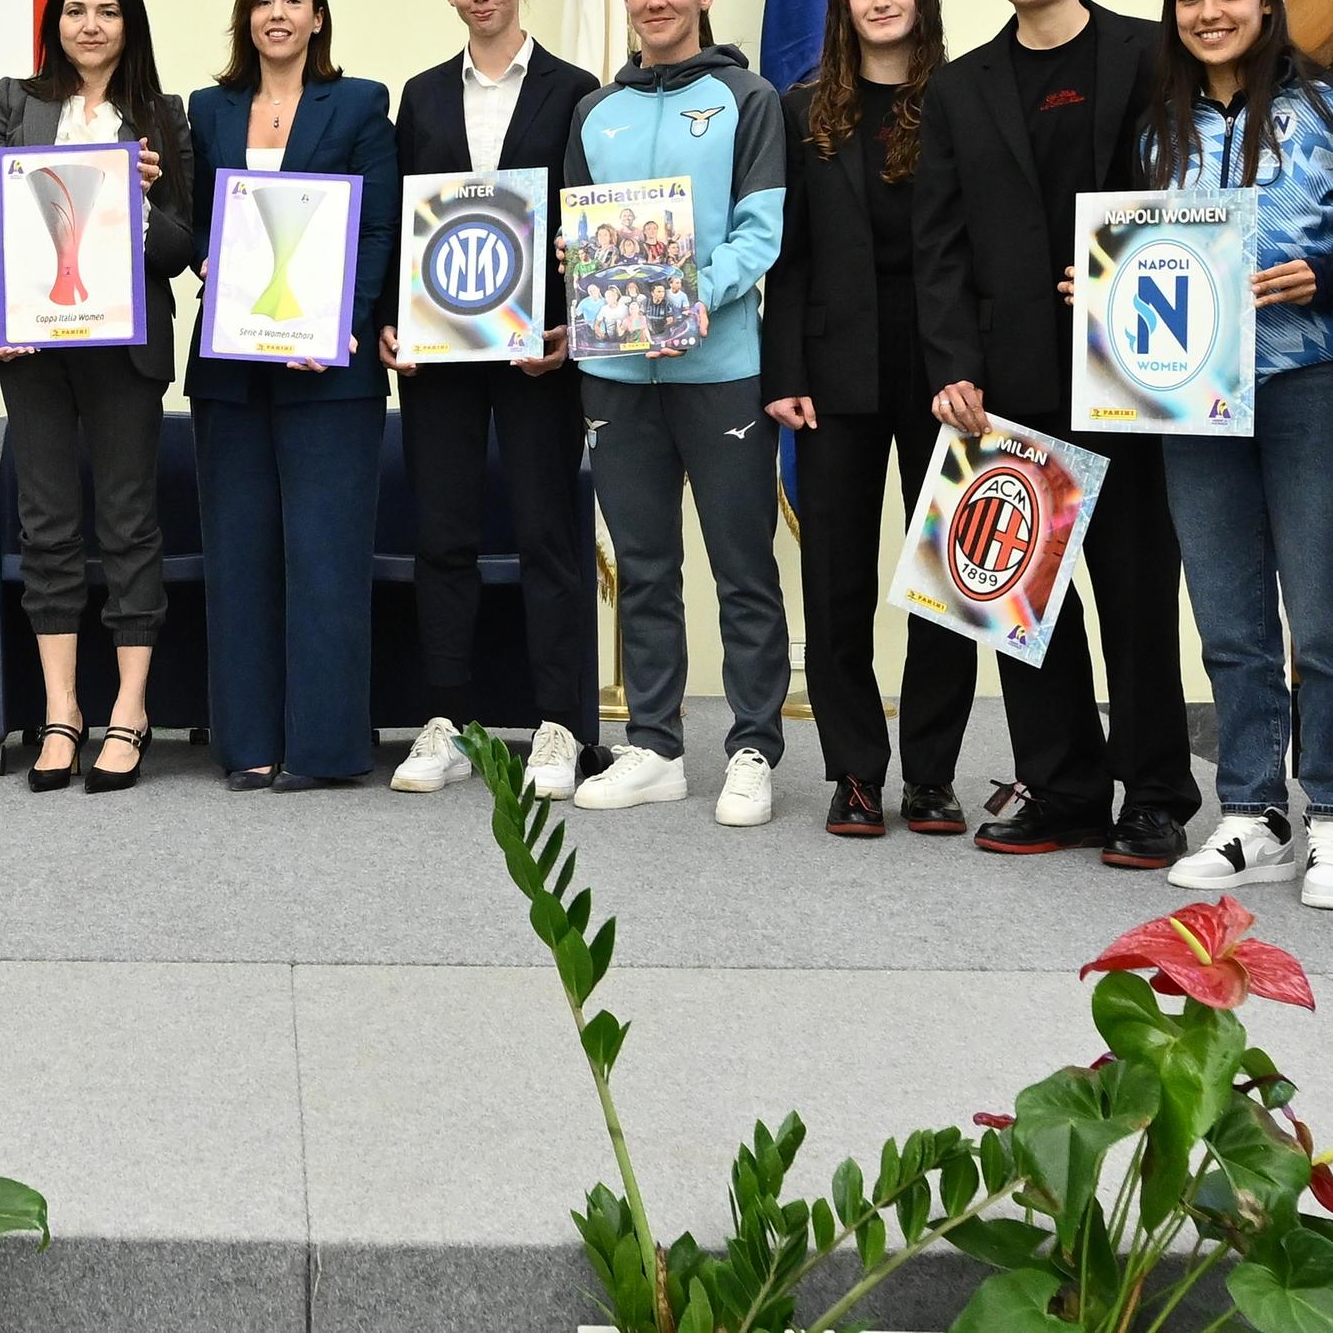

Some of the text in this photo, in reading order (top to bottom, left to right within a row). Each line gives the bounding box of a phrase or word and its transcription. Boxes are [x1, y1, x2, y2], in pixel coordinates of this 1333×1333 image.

[455, 185, 495, 199] INTER
[564, 185, 664, 207] Calciatrici
[1104, 207, 1227, 224] NAPOLI WOMEN
[1138, 259, 1189, 270] NAPOLI
[35, 313, 105, 324] Coppa Italia Women
[239, 328, 256, 337] Serie
[264, 329, 290, 338] Women
[1137, 361, 1188, 372] WOMEN
[996, 435, 1048, 467] MILAN
[982, 479, 1027, 511] ACM
[961, 563, 999, 587] 1899
[917, 594, 945, 610] PANINI
